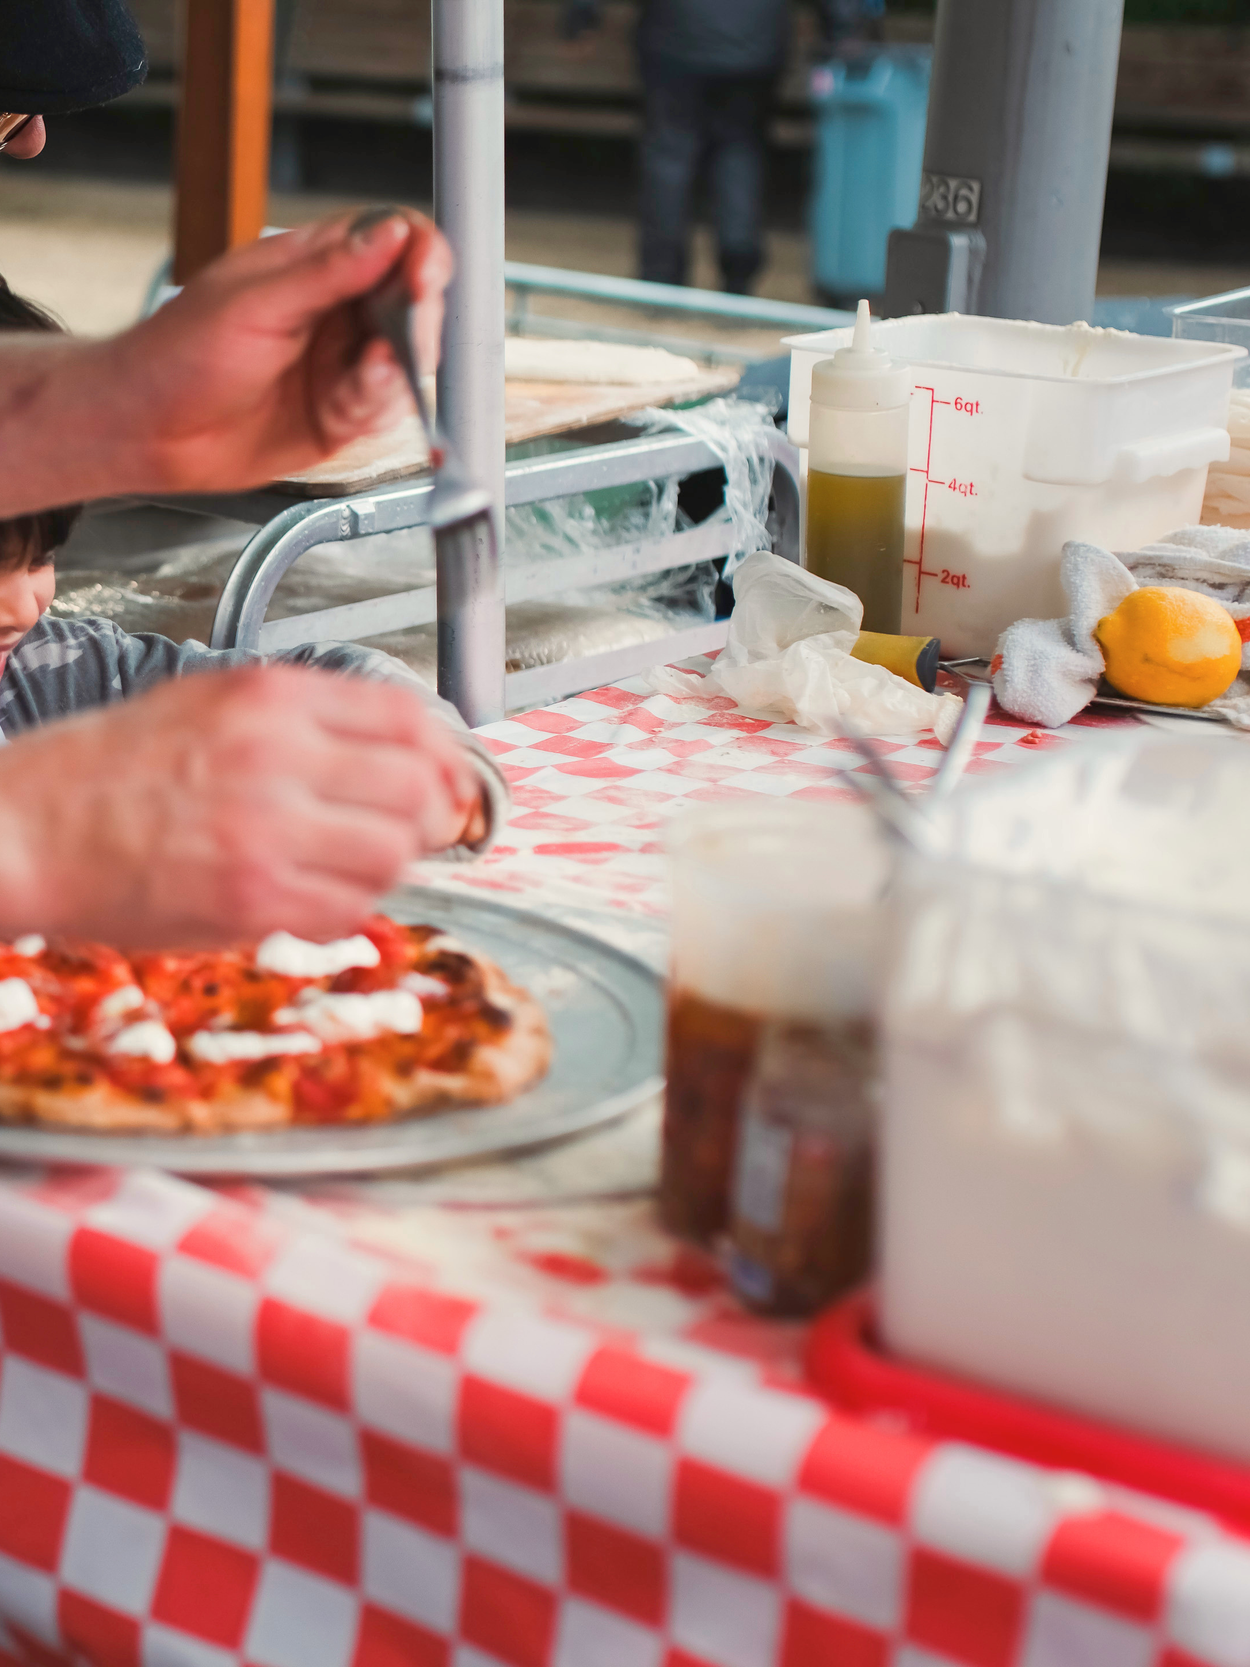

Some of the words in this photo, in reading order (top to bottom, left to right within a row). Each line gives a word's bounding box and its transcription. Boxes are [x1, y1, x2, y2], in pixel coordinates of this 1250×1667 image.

[954, 396, 983, 417] 6qt.
[948, 478, 978, 497] 4qt.
[940, 569, 970, 590] 2qt.
